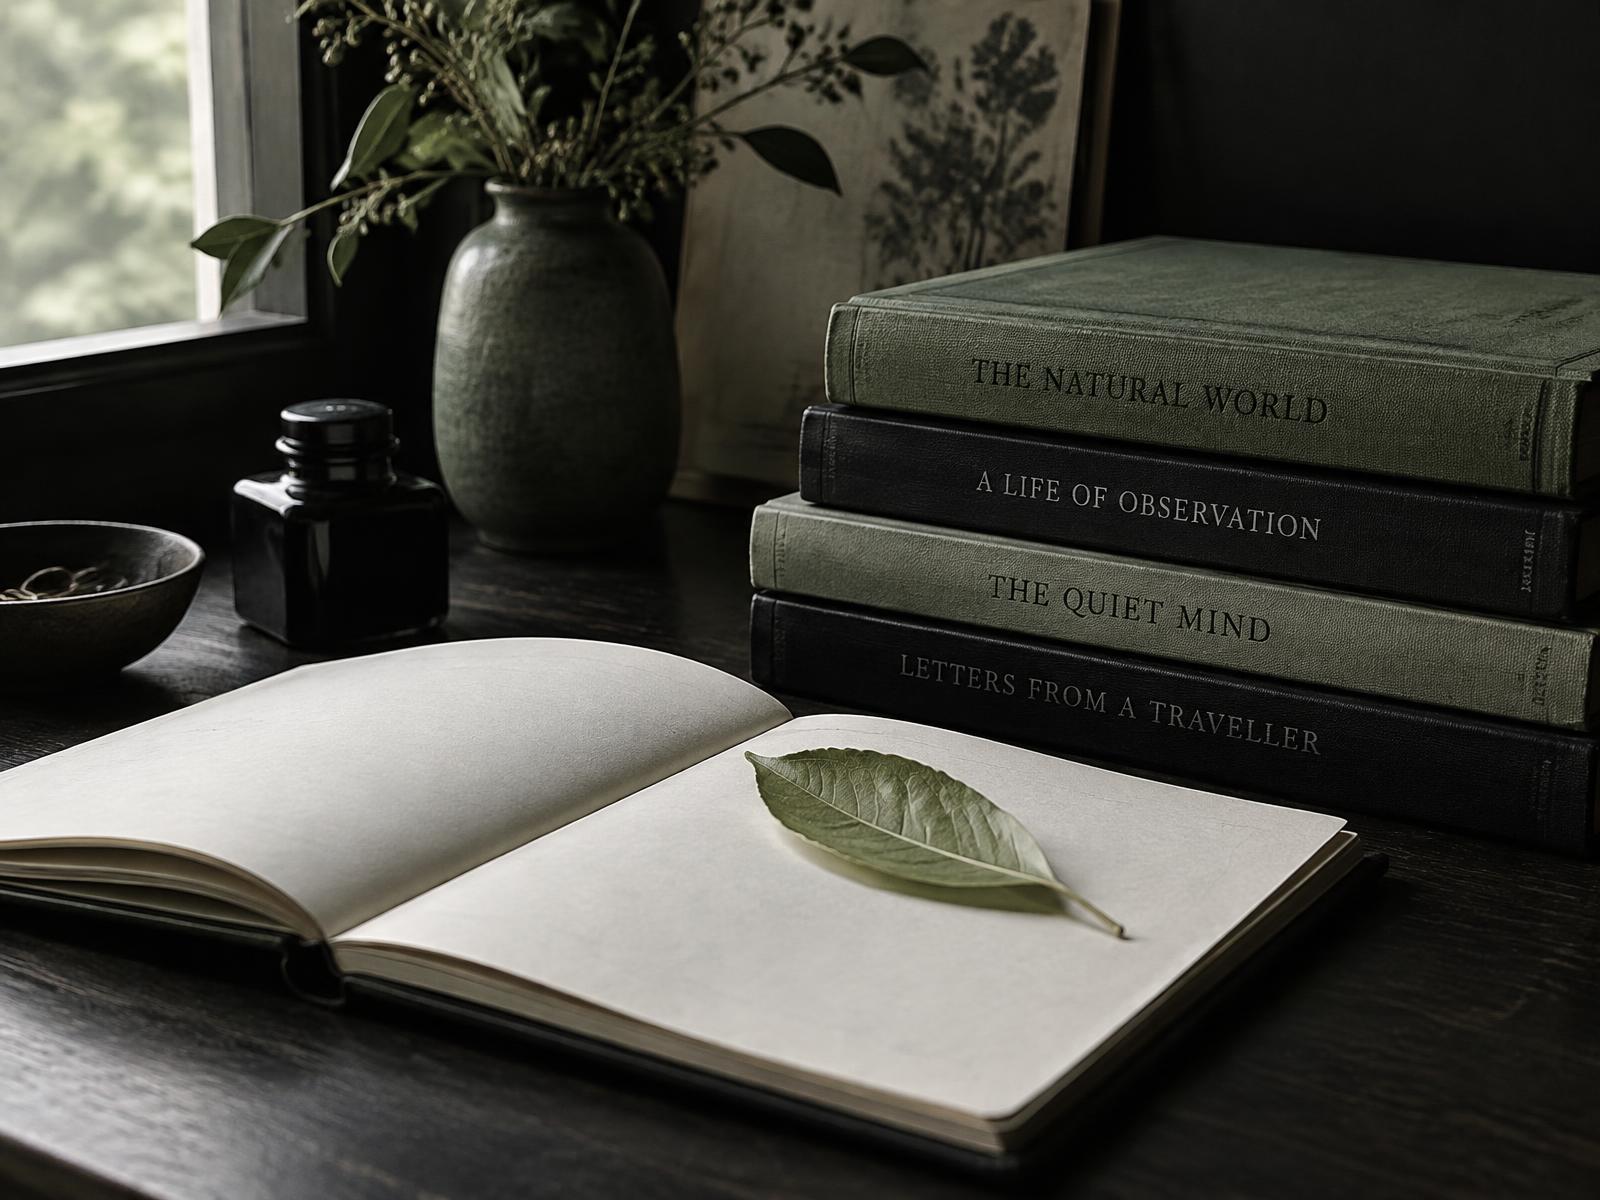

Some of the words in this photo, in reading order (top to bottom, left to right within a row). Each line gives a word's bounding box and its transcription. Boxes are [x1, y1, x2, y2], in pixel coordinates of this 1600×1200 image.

[972, 358, 1031, 389] THE
[1043, 368, 1191, 408] NATURAL
[1203, 384, 1328, 425] WORLD
[976, 471, 993, 492] A
[1003, 473, 1060, 502] LIFE
[1072, 483, 1107, 509] OF
[1119, 490, 1321, 541] OBSERVATION
[988, 574, 1050, 607] THE
[1063, 587, 1164, 624] QUIET
[1176, 604, 1271, 643] MIND
[900, 653, 1016, 695] LETTERS
[1028, 678, 1106, 713] FROM
[1118, 696, 1136, 719] A
[1149, 700, 1321, 756] TRAVELLER
